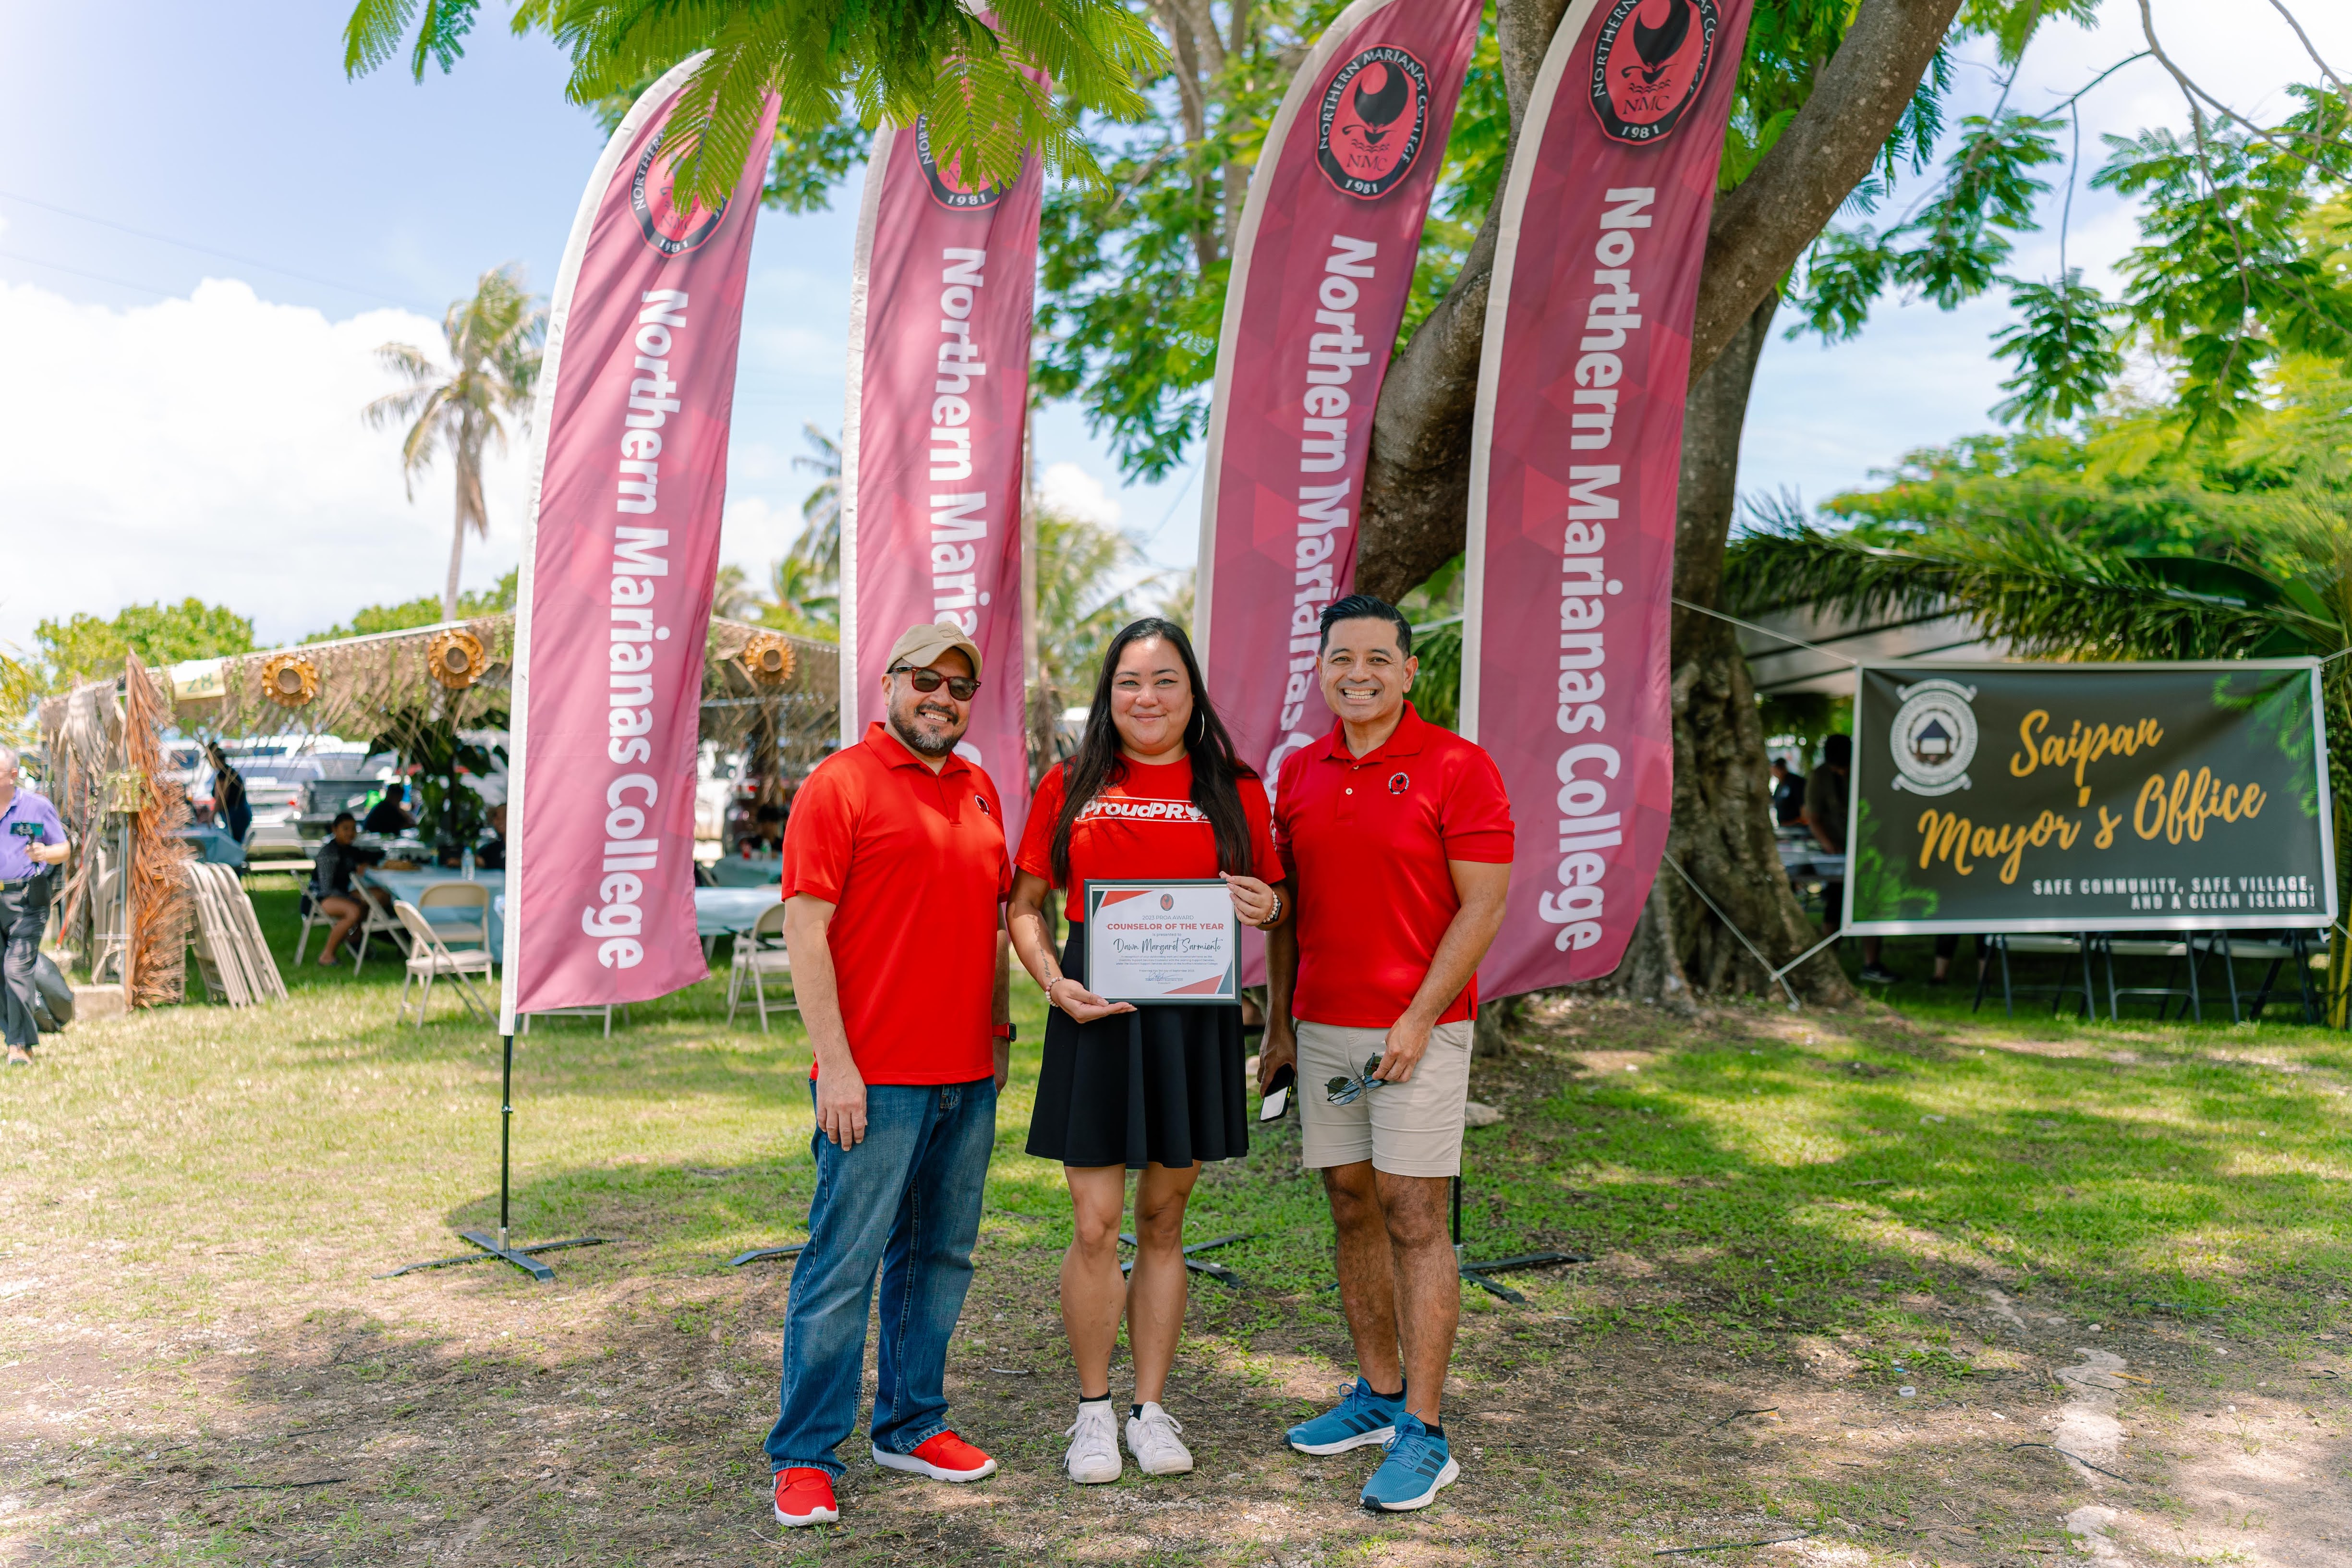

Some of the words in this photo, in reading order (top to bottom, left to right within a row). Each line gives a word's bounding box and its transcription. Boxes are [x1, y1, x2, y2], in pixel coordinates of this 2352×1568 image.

[1319, 61, 1360, 150] NORTHERN
[1621, 123, 1660, 139] 1981
[1622, 95, 1670, 115] NMC
[947, 193, 987, 206] 1981
[1345, 179, 1378, 194] 1981
[1346, 153, 1388, 171] NMC
[658, 239, 689, 254] 1981
[1299, 233, 1378, 473] Northern
[1570, 186, 1656, 450] Northern
[617, 288, 689, 515] Northern
[929, 247, 987, 481] Northern
[1556, 464, 1624, 734] Marianas
[607, 525, 671, 765] Marianas
[2009, 708, 2164, 788] Saipan
[1538, 742, 1623, 952] College
[1917, 786, 2123, 885] Mayor's
[2133, 766, 2267, 846] Office
[581, 772, 659, 969] College
[2032, 878, 2073, 896] SAFE
[2079, 877, 2184, 896] COMMUNITY,
[2191, 876, 2231, 893] SAFE
[2238, 875, 2315, 893] VILLAGE,
[2130, 893, 2163, 910] AND
[2170, 893, 2182, 910] A
[2188, 892, 2240, 909] CLEAN
[2247, 891, 2316, 908] ISLAND!
[1113, 938, 1140, 953] Dawn
[1141, 937, 1184, 954] Margaret
[1182, 937, 1223, 953] Sarmiento
